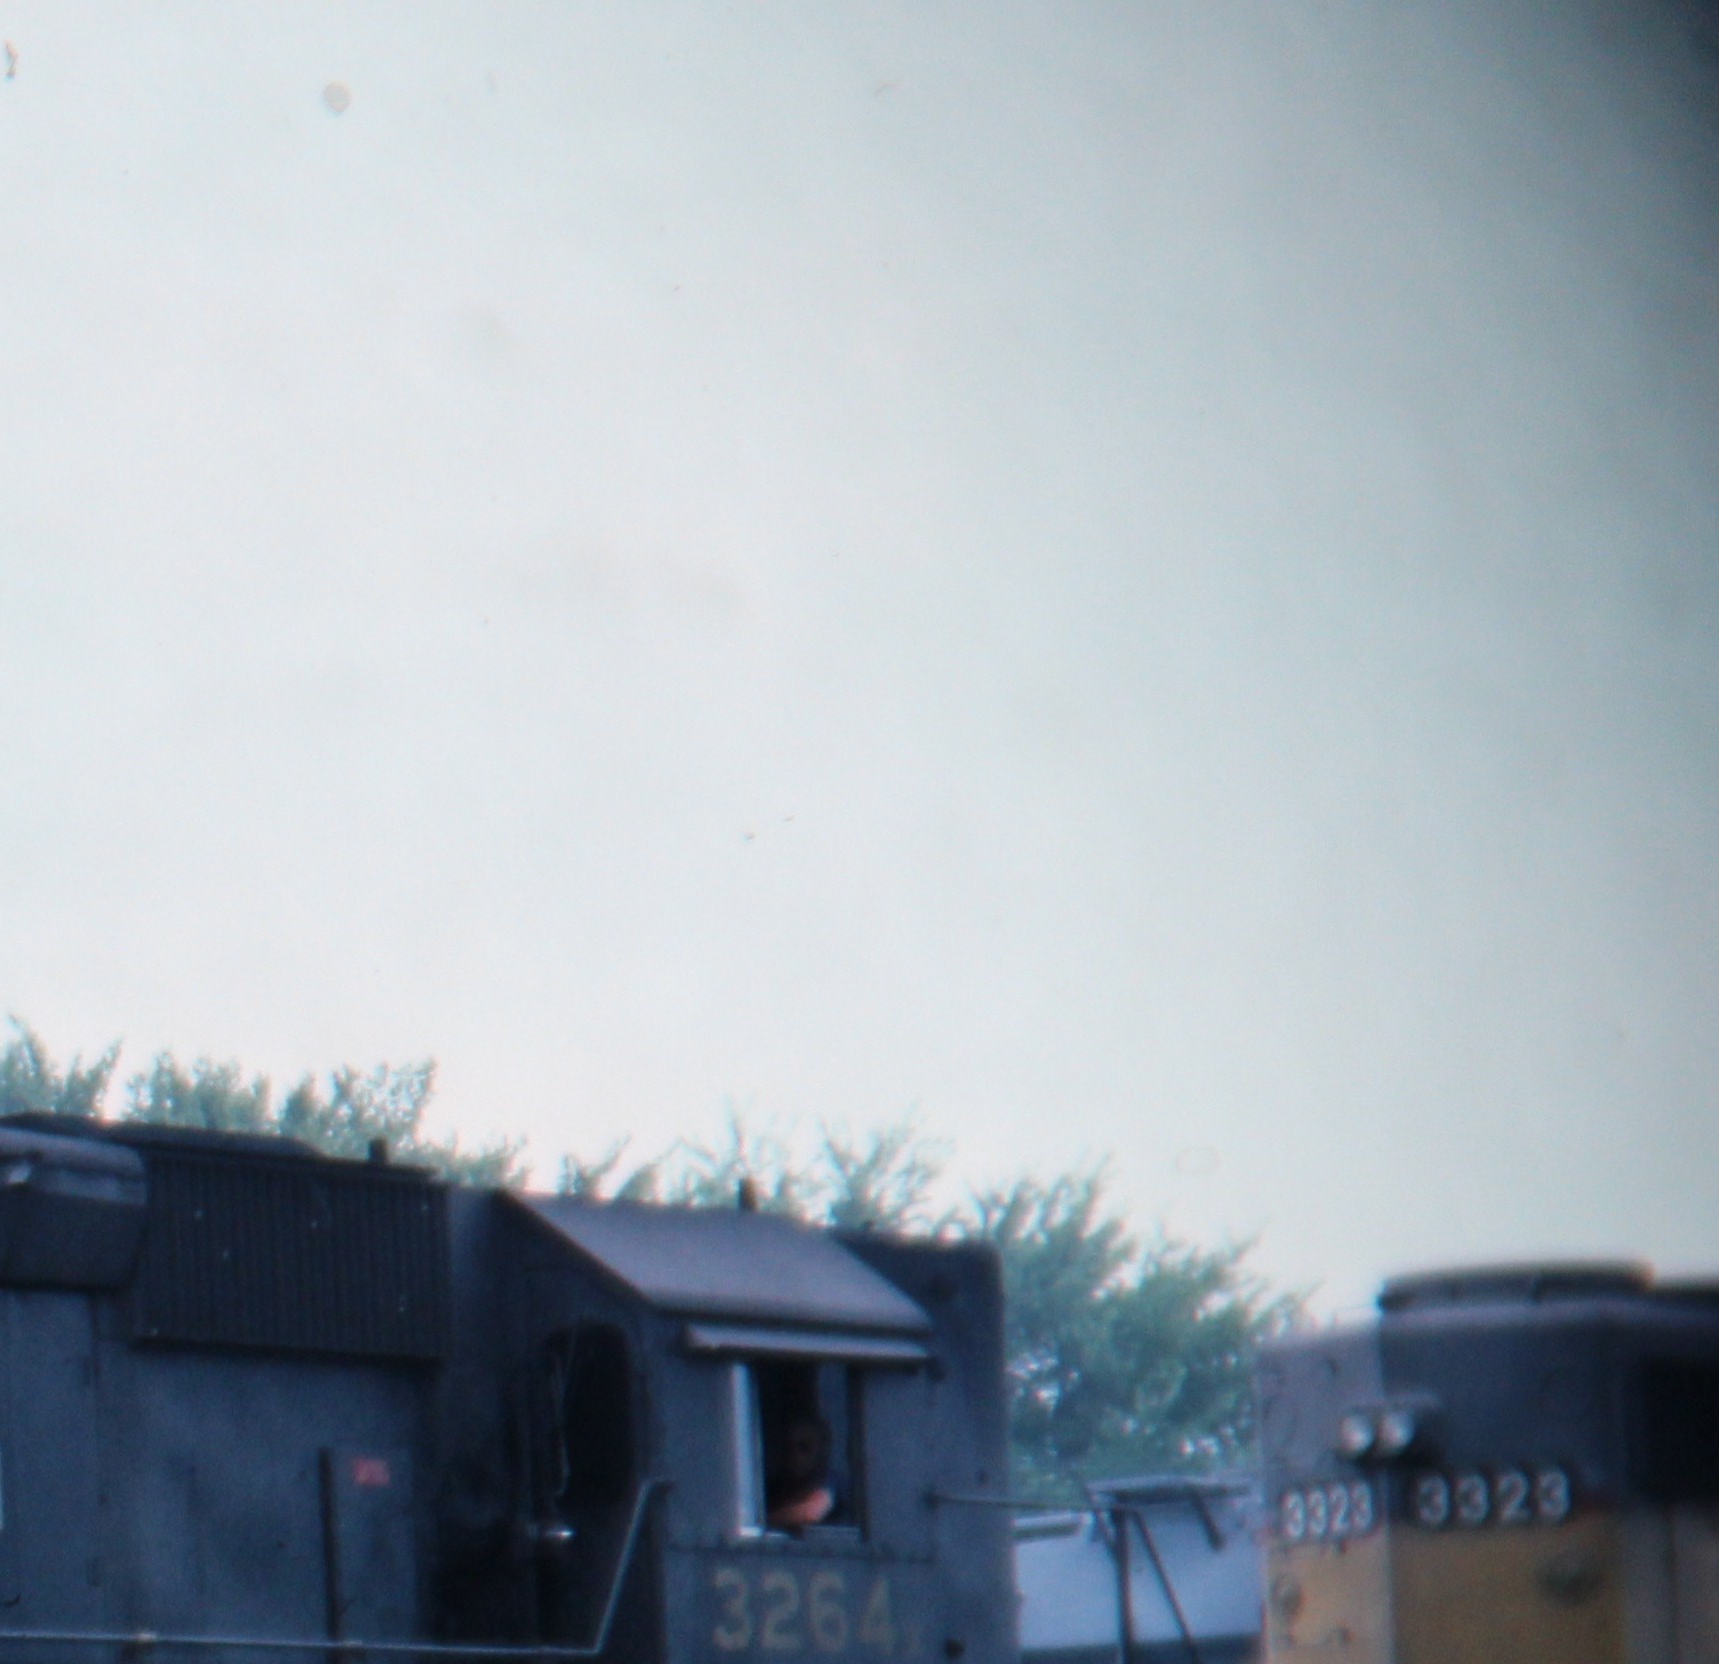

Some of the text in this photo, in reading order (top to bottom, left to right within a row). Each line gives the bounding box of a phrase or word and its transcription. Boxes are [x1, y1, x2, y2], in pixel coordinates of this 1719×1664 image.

[1280, 1479, 1375, 1541] 3323
[1416, 1466, 1572, 1528] 3323
[712, 1566, 898, 1656] 3264
